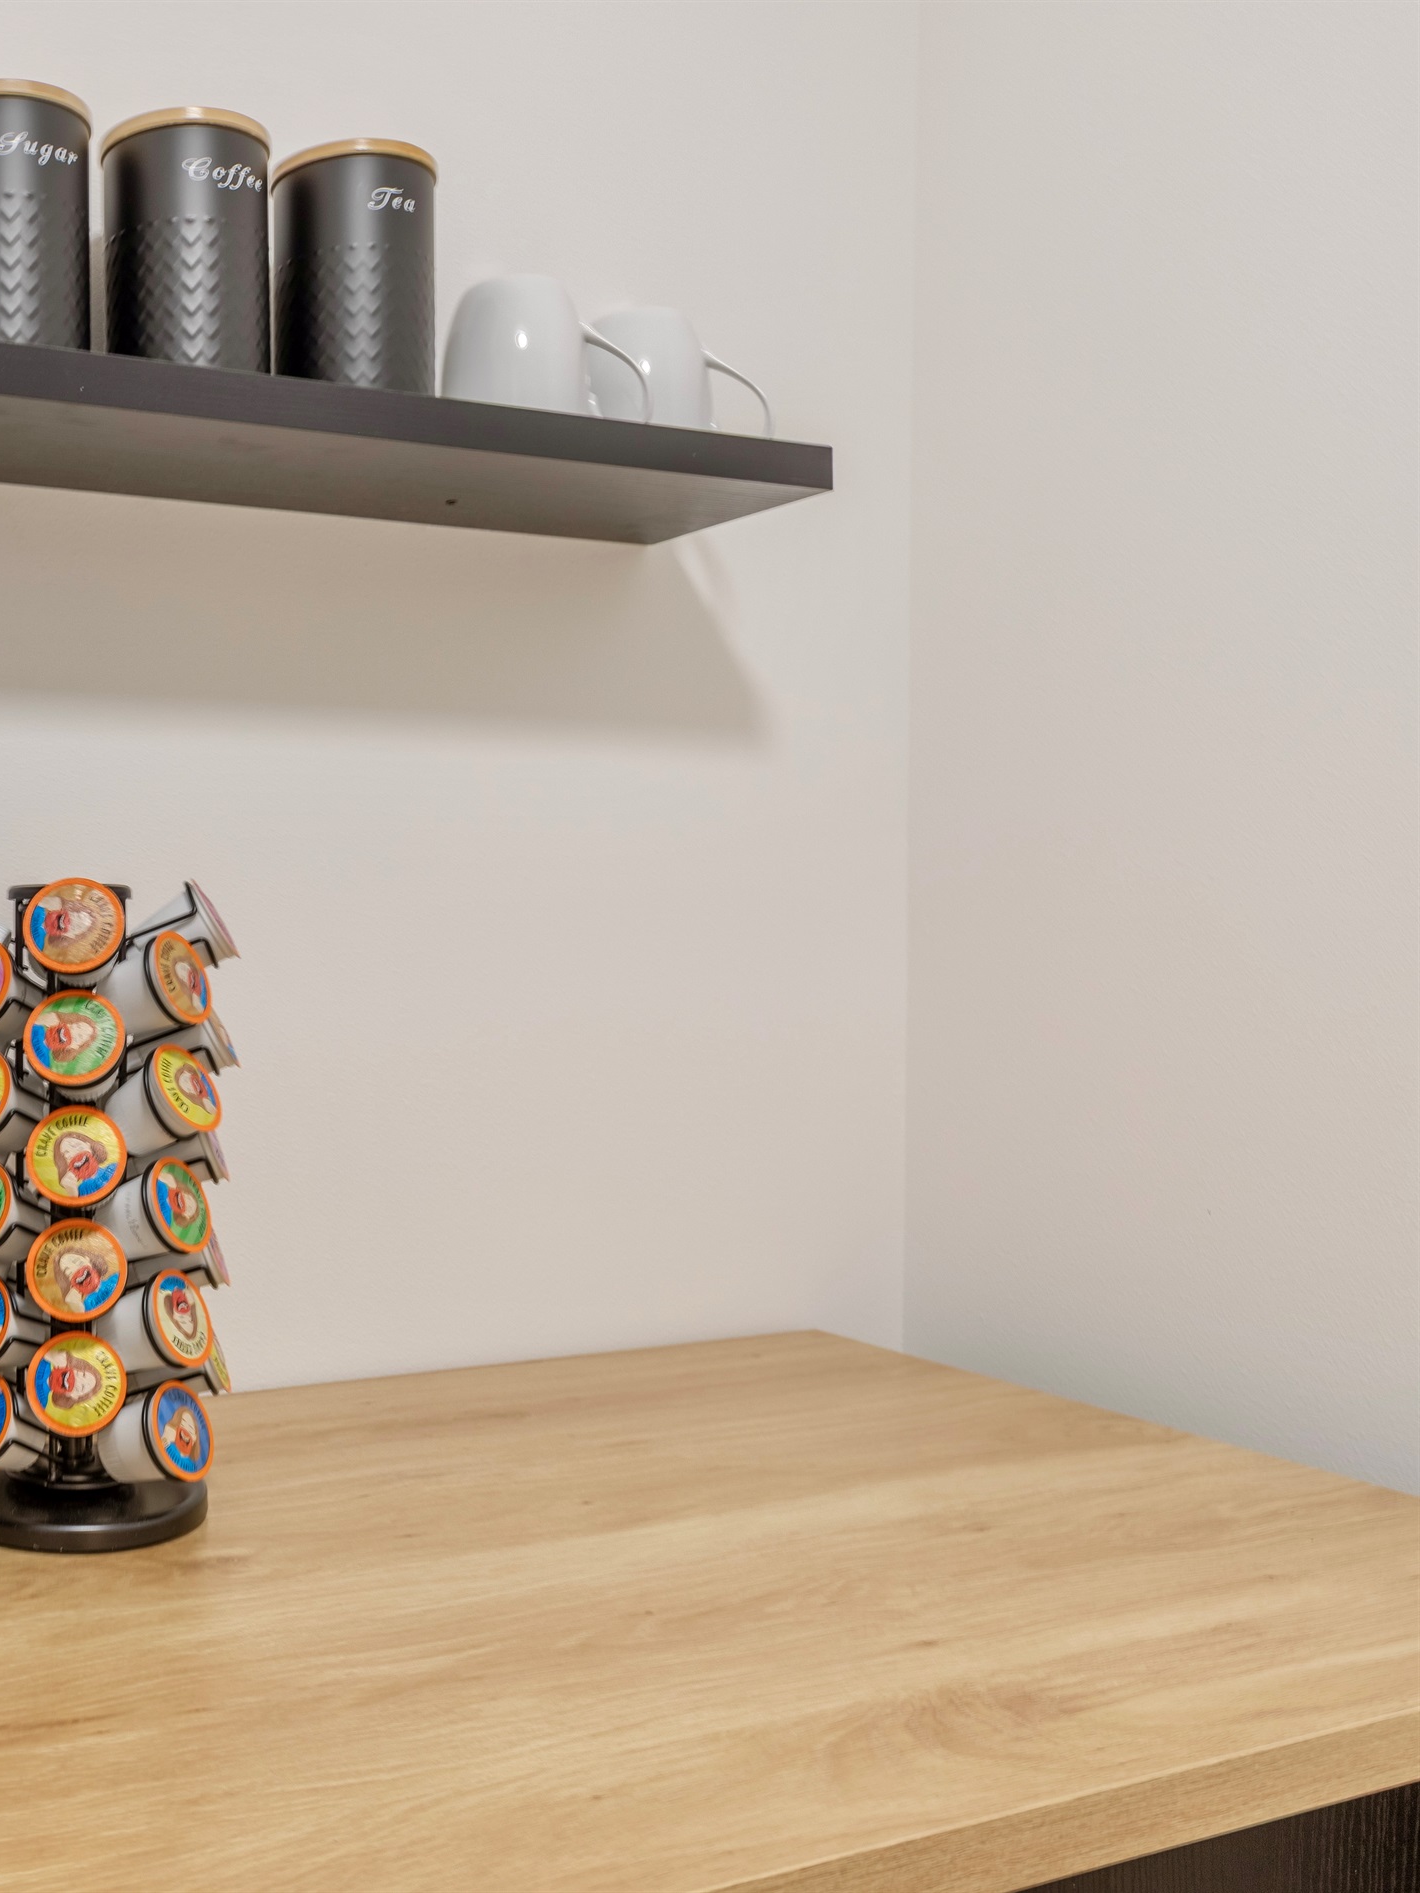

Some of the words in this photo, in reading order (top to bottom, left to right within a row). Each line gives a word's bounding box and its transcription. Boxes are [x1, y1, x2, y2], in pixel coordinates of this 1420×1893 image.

[182, 157, 263, 192] Coffee
[367, 187, 416, 213] Tea
[35, 1125, 58, 1157] CRAVE
[56, 1114, 90, 1131] COFFEE
[94, 1384, 118, 1417] COFFEE
